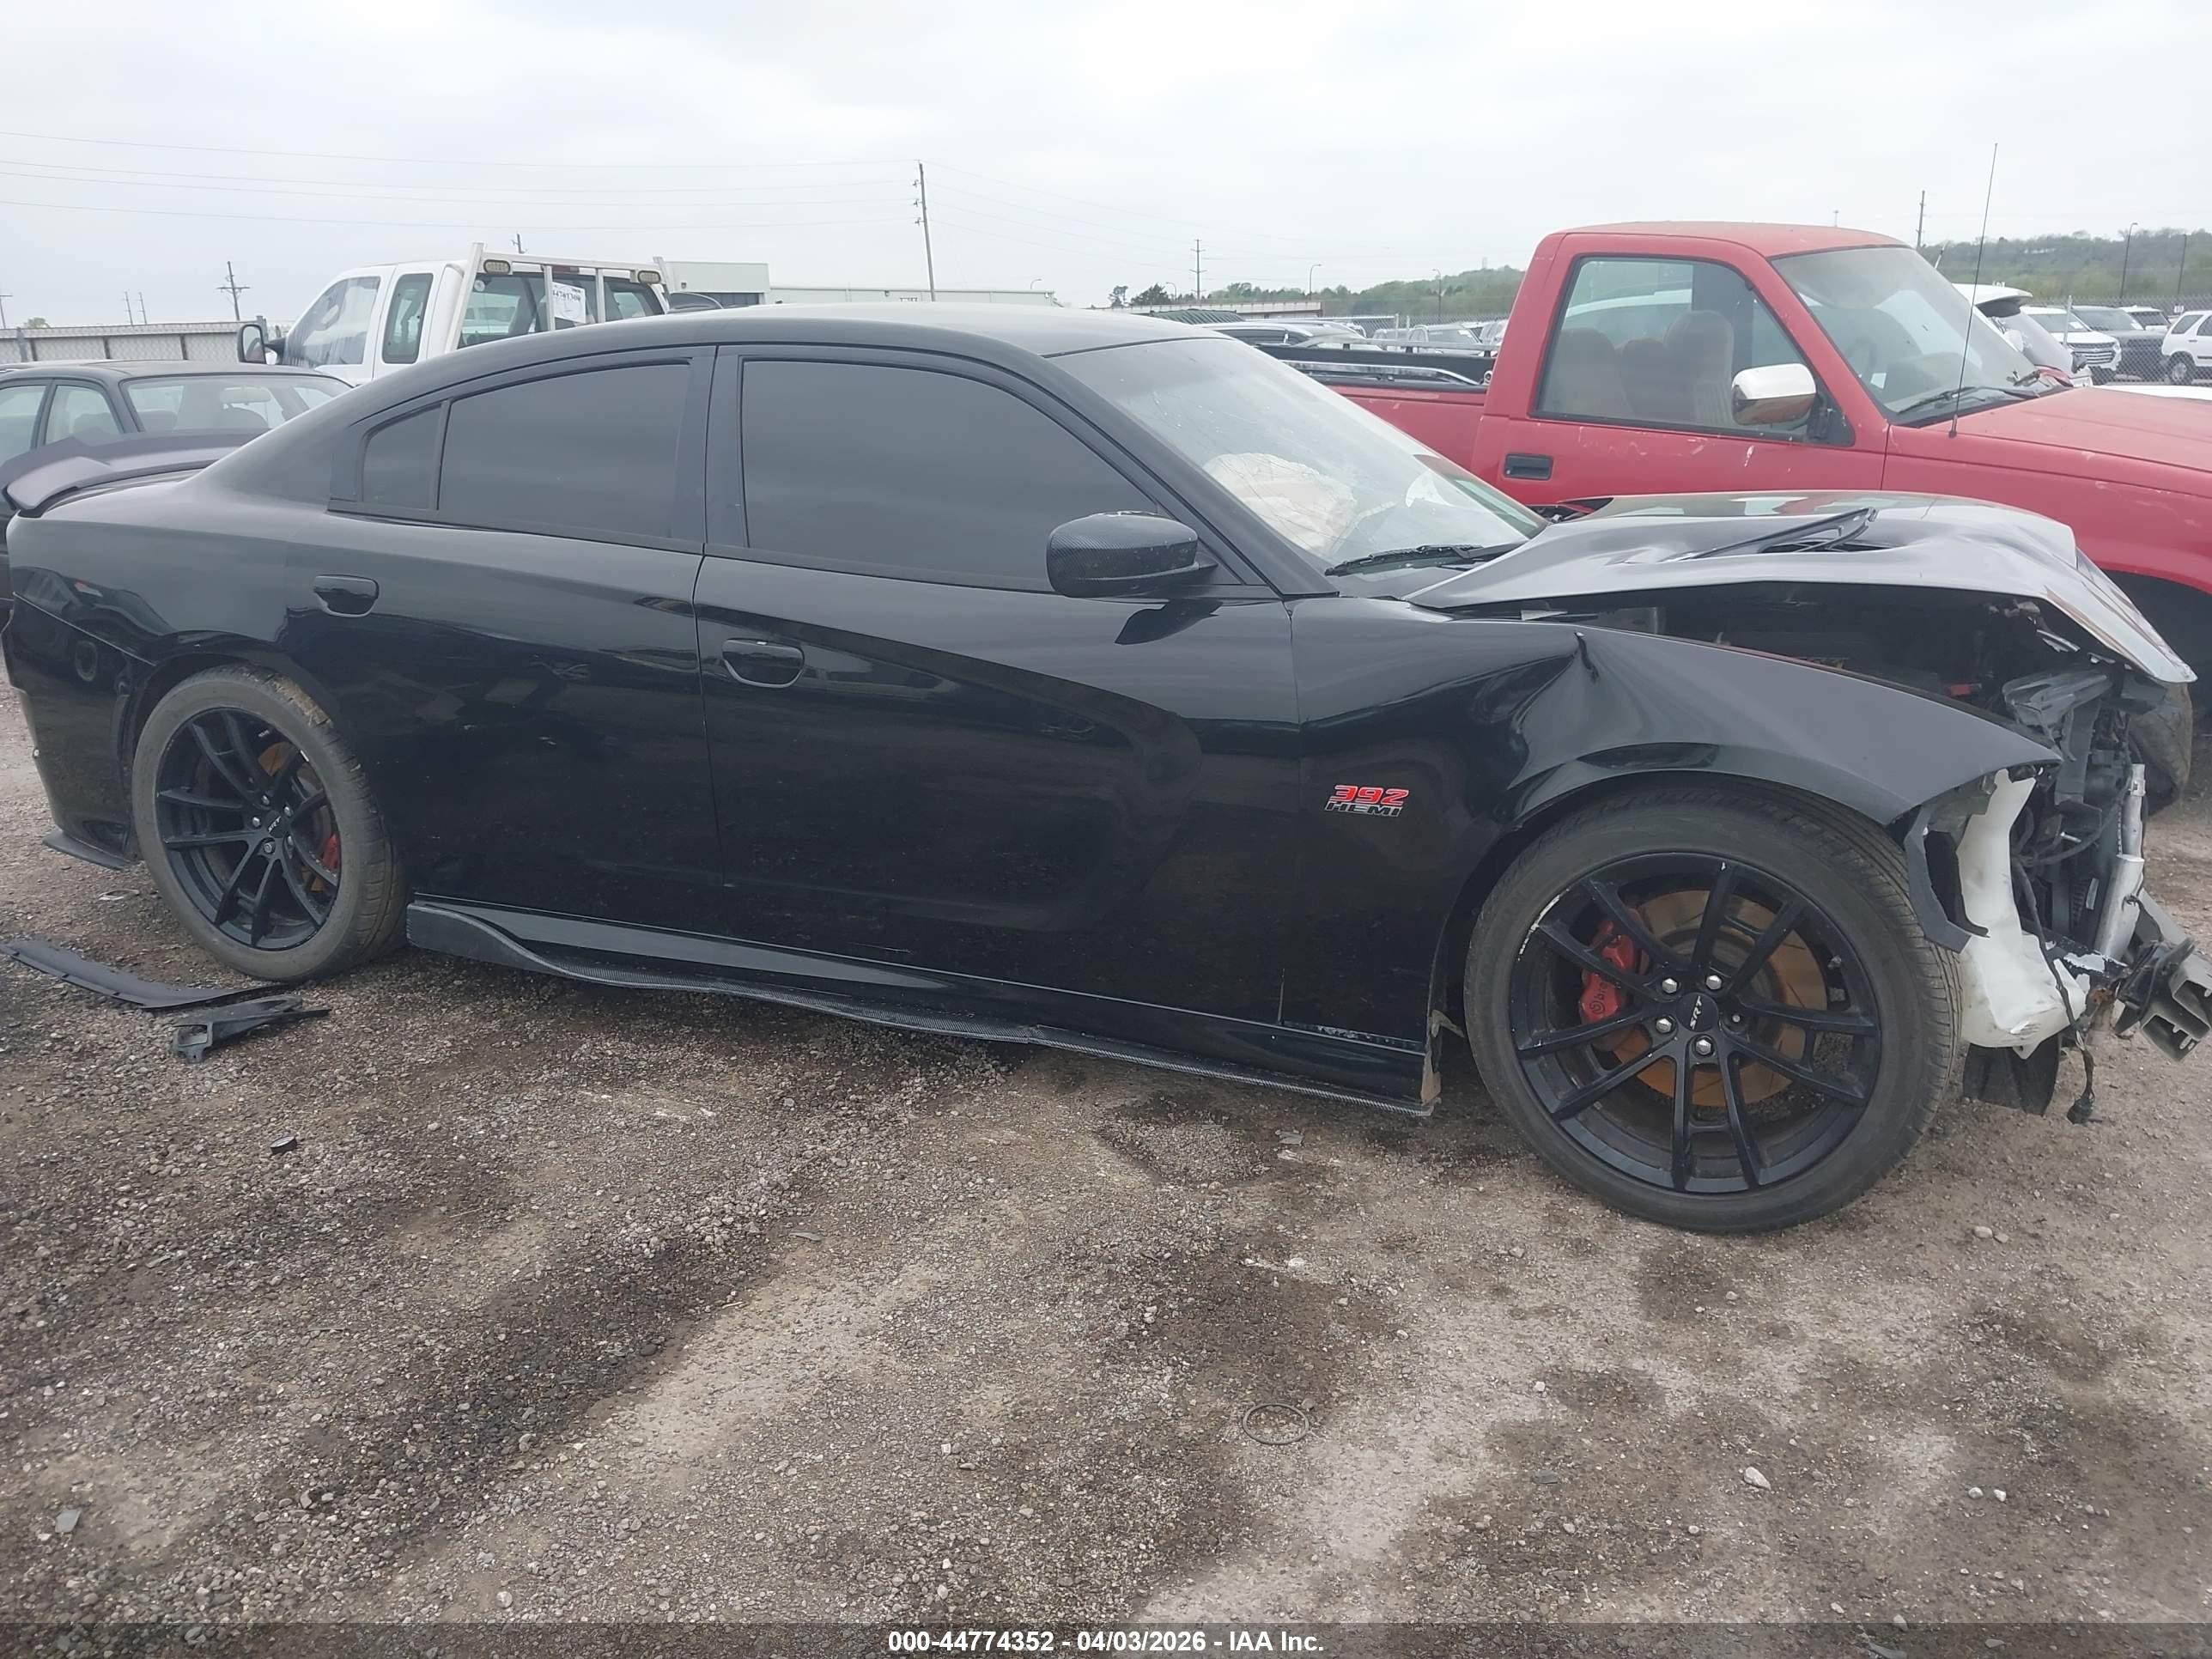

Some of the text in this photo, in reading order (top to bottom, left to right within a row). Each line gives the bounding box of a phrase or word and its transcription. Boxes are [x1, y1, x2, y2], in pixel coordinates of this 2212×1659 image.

[1329, 785, 1409, 805] 392
[1325, 800, 1402, 817] HEMI
[1690, 996, 1702, 1030] SRT
